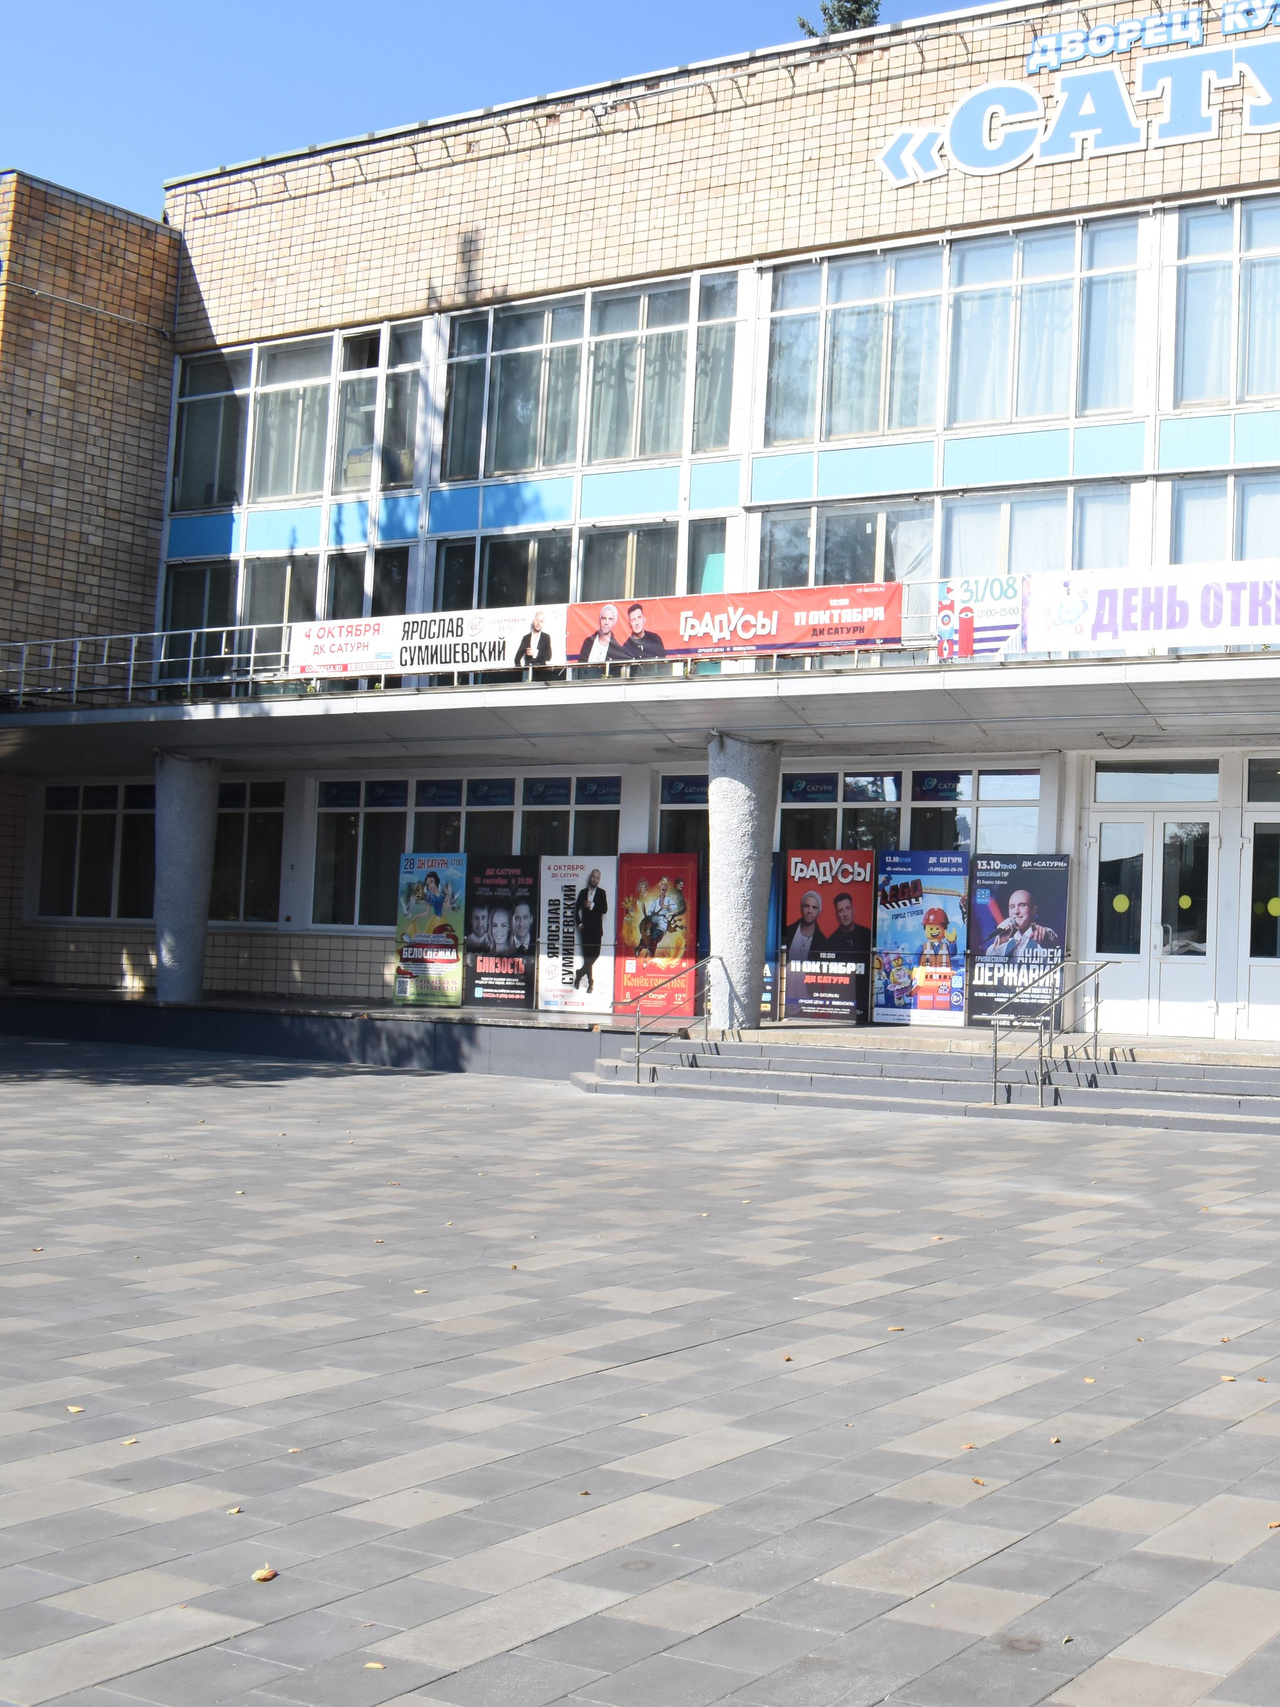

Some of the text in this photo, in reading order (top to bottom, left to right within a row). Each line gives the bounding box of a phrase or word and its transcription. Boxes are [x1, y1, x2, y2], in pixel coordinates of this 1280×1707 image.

[1026, 8, 1202, 74] ДВОРЕЦ
[960, 576, 1018, 604] 31/08
[794, 606, 885, 626] 11 ОКТЯБРЯ
[977, 606, 1020, 619] 12:00-15:00
[1091, 584, 1190, 641] ДЕНЬ
[305, 622, 381, 640] 4 ОКТЯБРЯ
[401, 617, 464, 642] ЯРОСЛАВ
[680, 606, 779, 643] ГРАДУСЫ
[811, 625, 865, 638] ДК САТУРН
[313, 642, 369, 656] ДК САТУРН
[400, 637, 507, 667] СУМИШЕВСКИЙ
[806, 784, 833, 792] САТУРН
[403, 858, 415, 870] 28
[426, 858, 448, 869] САТУРН
[790, 856, 872, 885] ГРАДУСЫ
[976, 860, 1001, 870] 13.10
[882, 896, 923, 910] ШОУ
[891, 911, 907, 921] ГОРОД
[547, 898, 561, 959] ЯРОСЛАВ
[561, 884, 577, 985] СУМИШЕВСКИЙ
[402, 947, 457, 960] БЕЛОСНЕЖКА
[1017, 945, 1061, 964] АНДРЕЙ
[476, 956, 525, 975] БЛИЗОСТЬ
[790, 960, 865, 975] 11 ОКТЯБРЯ
[803, 974, 850, 985] ДК САТУРН
